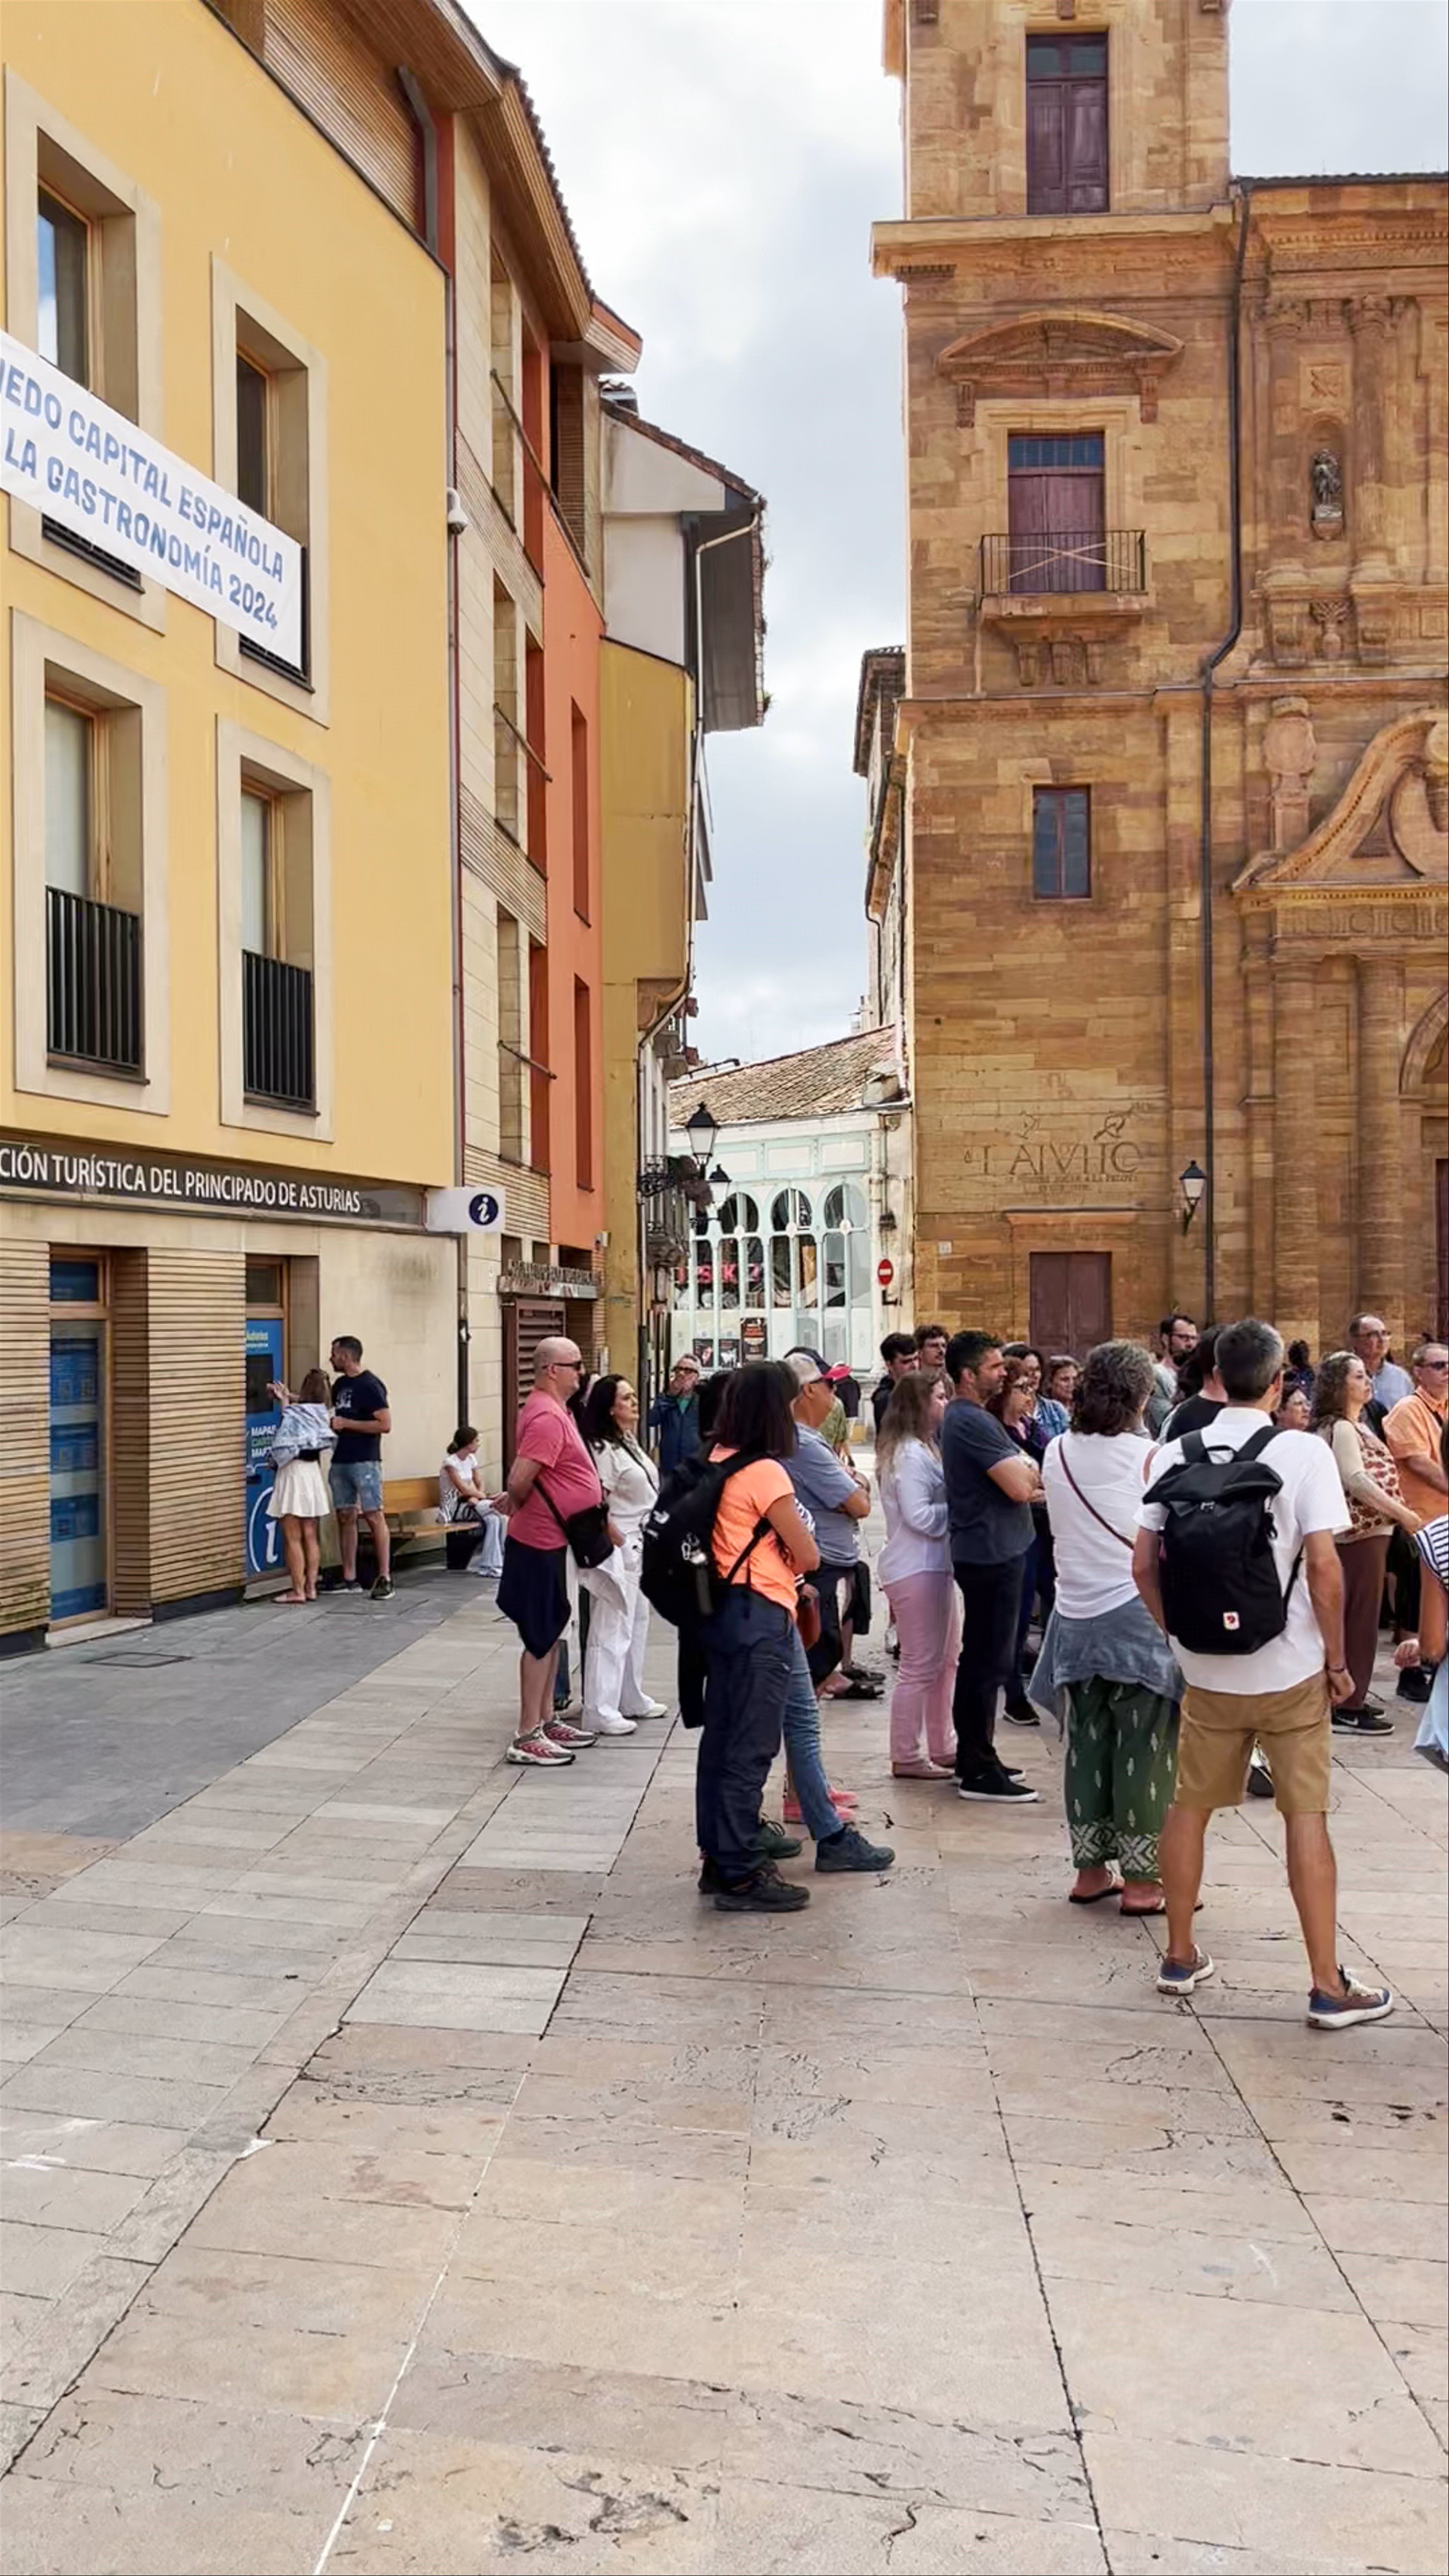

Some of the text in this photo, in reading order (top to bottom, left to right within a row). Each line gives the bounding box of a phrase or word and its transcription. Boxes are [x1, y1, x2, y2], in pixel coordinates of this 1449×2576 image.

[5, 426, 278, 631] LA GASTRONOMÍA 2024
[68, 409, 172, 509] CAPITAL
[178, 485, 284, 583] ESPAÑOLA
[0, 1146, 361, 1212] CIÓN TURÍSTICA DEL PRINCIPADO DE ASTURIAS
